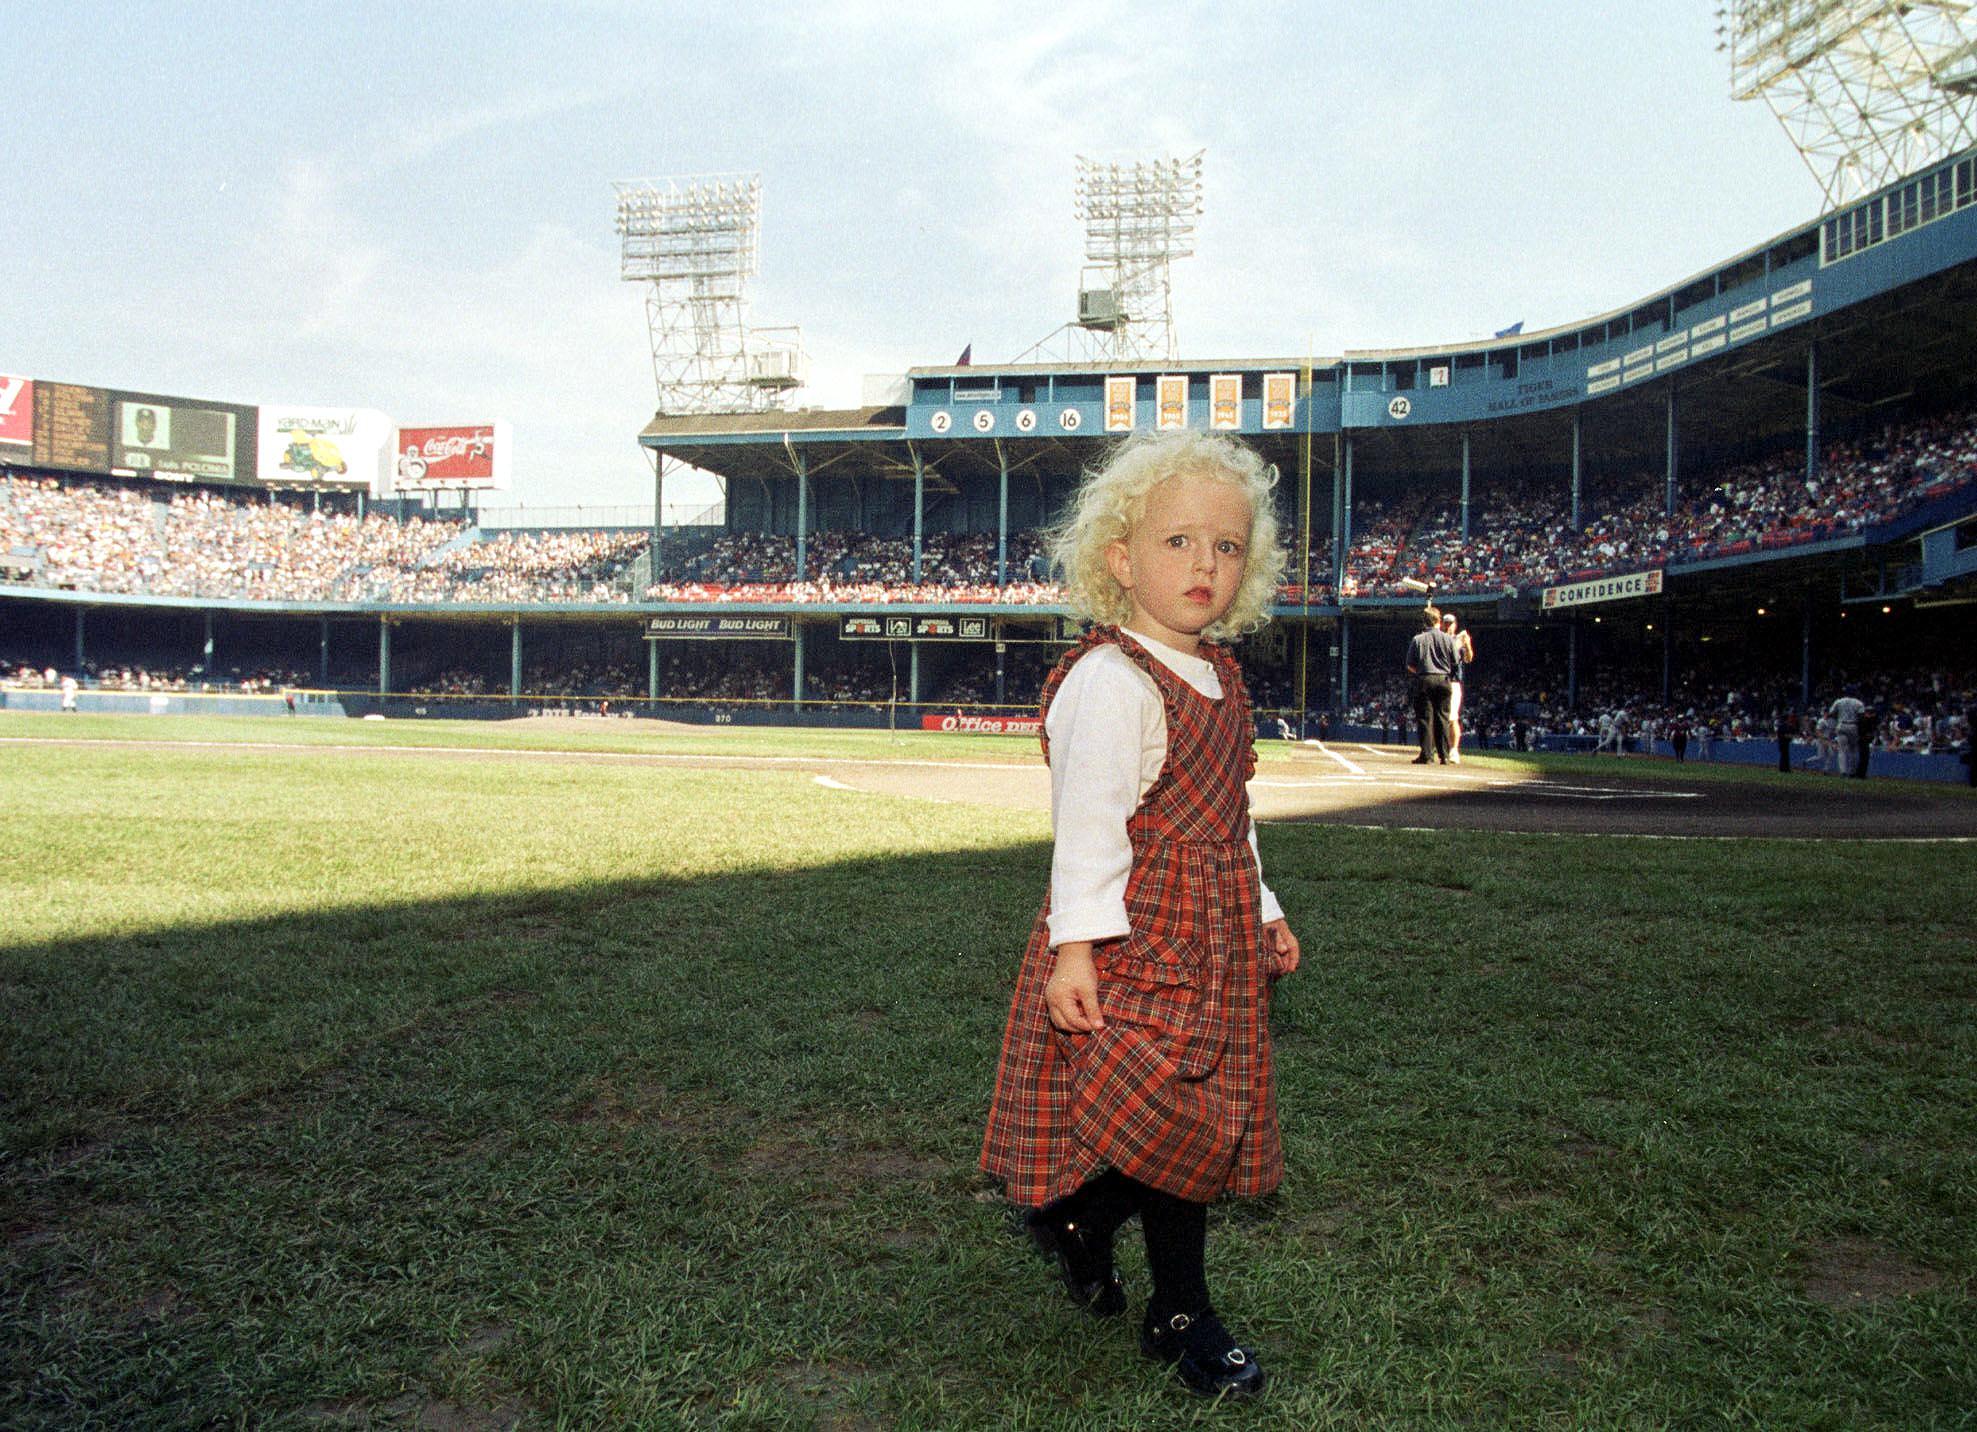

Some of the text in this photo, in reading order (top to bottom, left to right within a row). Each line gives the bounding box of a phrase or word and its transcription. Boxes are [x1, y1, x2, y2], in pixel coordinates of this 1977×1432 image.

[1390, 402, 1407, 414] 42
[937, 416, 946, 429] 2
[979, 414, 988, 428] 5
[1021, 414, 1031, 427] 6
[1063, 413, 1077, 427] 16
[1560, 579, 1640, 602] CONFIDENCE
[651, 619, 780, 630] BUD LIGHT BUD LIGHT
[941, 717, 1002, 732] Office
